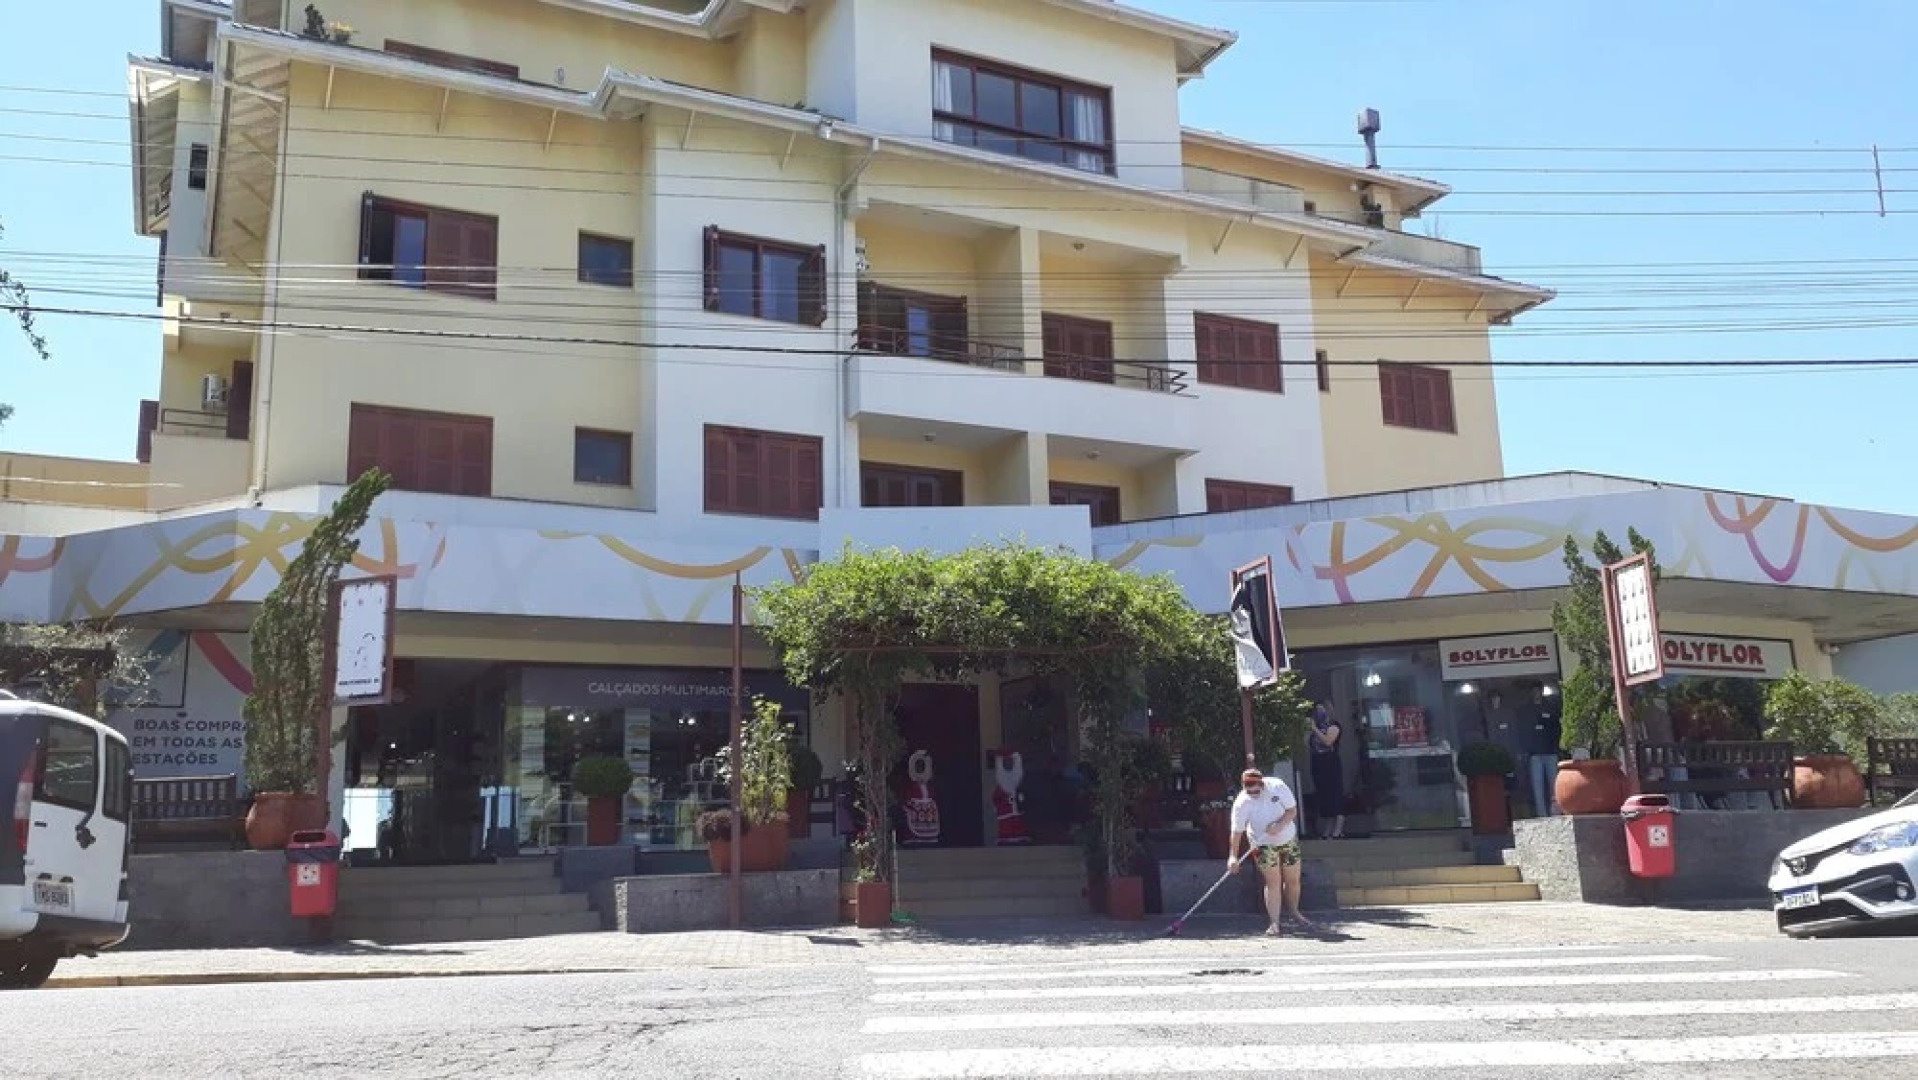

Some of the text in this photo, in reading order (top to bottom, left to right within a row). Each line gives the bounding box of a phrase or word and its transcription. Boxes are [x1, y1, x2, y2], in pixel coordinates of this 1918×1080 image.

[1663, 639, 1764, 665] OLYFLOR
[588, 682, 750, 697] CALÇADOS MULTIMARCS
[134, 719, 180, 731] BOAS
[132, 736, 243, 749] EM TODAS AS
[132, 751, 218, 766] ESTAÇÕES
